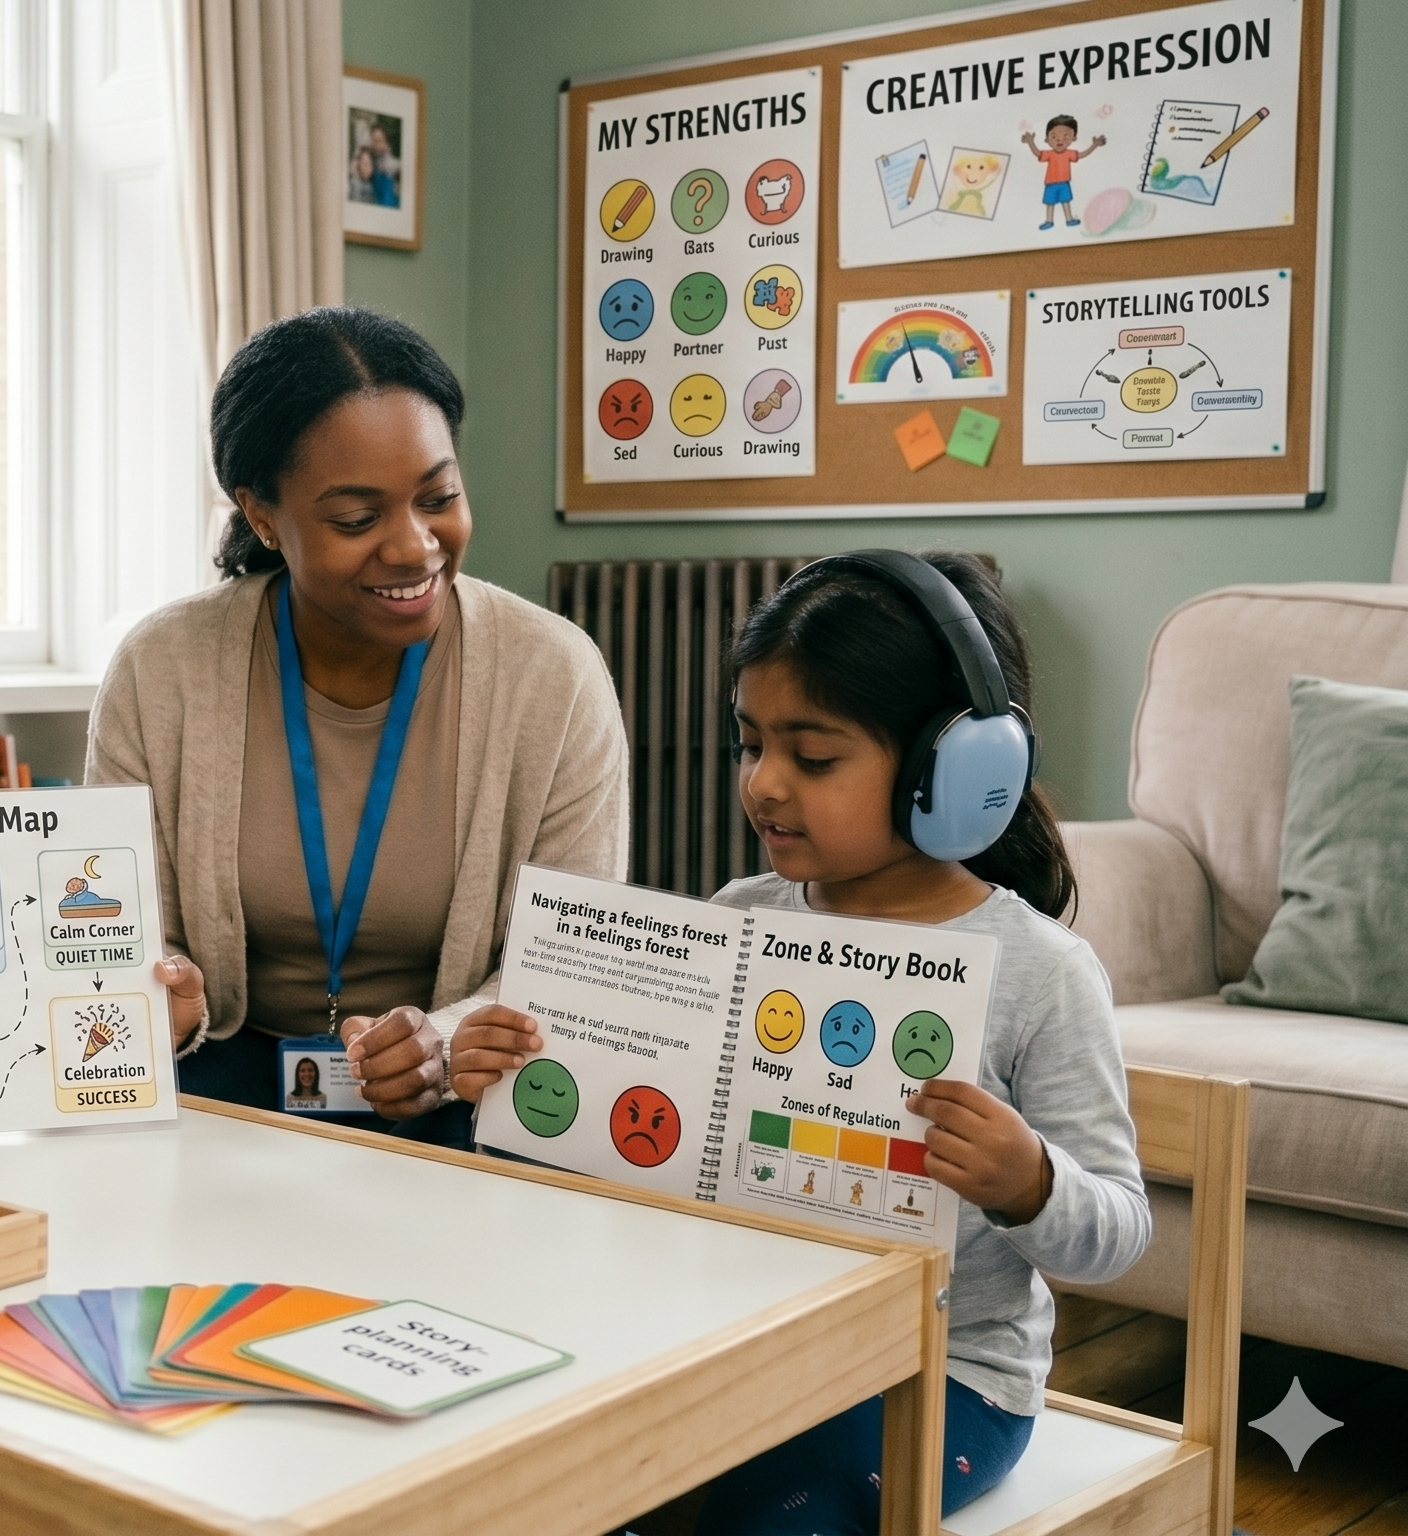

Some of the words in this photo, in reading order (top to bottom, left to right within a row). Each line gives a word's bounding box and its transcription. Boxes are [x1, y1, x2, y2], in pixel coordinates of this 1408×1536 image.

[865, 56, 1025, 116] CREATIVE
[1038, 17, 1271, 92] EXPRESSION
[598, 117, 638, 152] MY
[645, 92, 807, 146] STRENGTHS
[748, 231, 800, 249] Curious
[601, 247, 654, 264] Drawing
[1042, 291, 1194, 325] STORYTELLING
[1199, 284, 1270, 312] TOOLS
[758, 336, 788, 351] Pust
[606, 347, 647, 365] Happy
[614, 446, 637, 460] Sed
[673, 443, 724, 458] Curious
[743, 439, 800, 457] Drawing
[531, 892, 606, 924] Navigating
[609, 911, 617, 924] a
[621, 911, 678, 938] feelings
[682, 924, 728, 947] forest
[50, 924, 85, 940] Calm
[89, 924, 135, 938] Corner
[556, 918, 570, 934] in
[573, 925, 581, 937] a
[585, 924, 641, 951] feelings
[645, 937, 690, 960] forest
[56, 949, 97, 965] QUIET
[100, 948, 133, 962] TIME
[762, 933, 812, 962] Zone
[817, 940, 834, 965] &
[839, 943, 900, 980] Story
[906, 952, 968, 984] Book
[64, 1063, 145, 1081] Celebration
[752, 1056, 793, 1081] Happy
[827, 1072, 853, 1090] Sad
[77, 1089, 137, 1106] SUCCESS
[781, 1096, 814, 1114] Zones
[817, 1103, 831, 1117] of
[833, 1106, 900, 1131] Regulation
[397, 1321, 489, 1356] Story-
[342, 1325, 482, 1376] planning
[342, 1344, 425, 1376] cards
